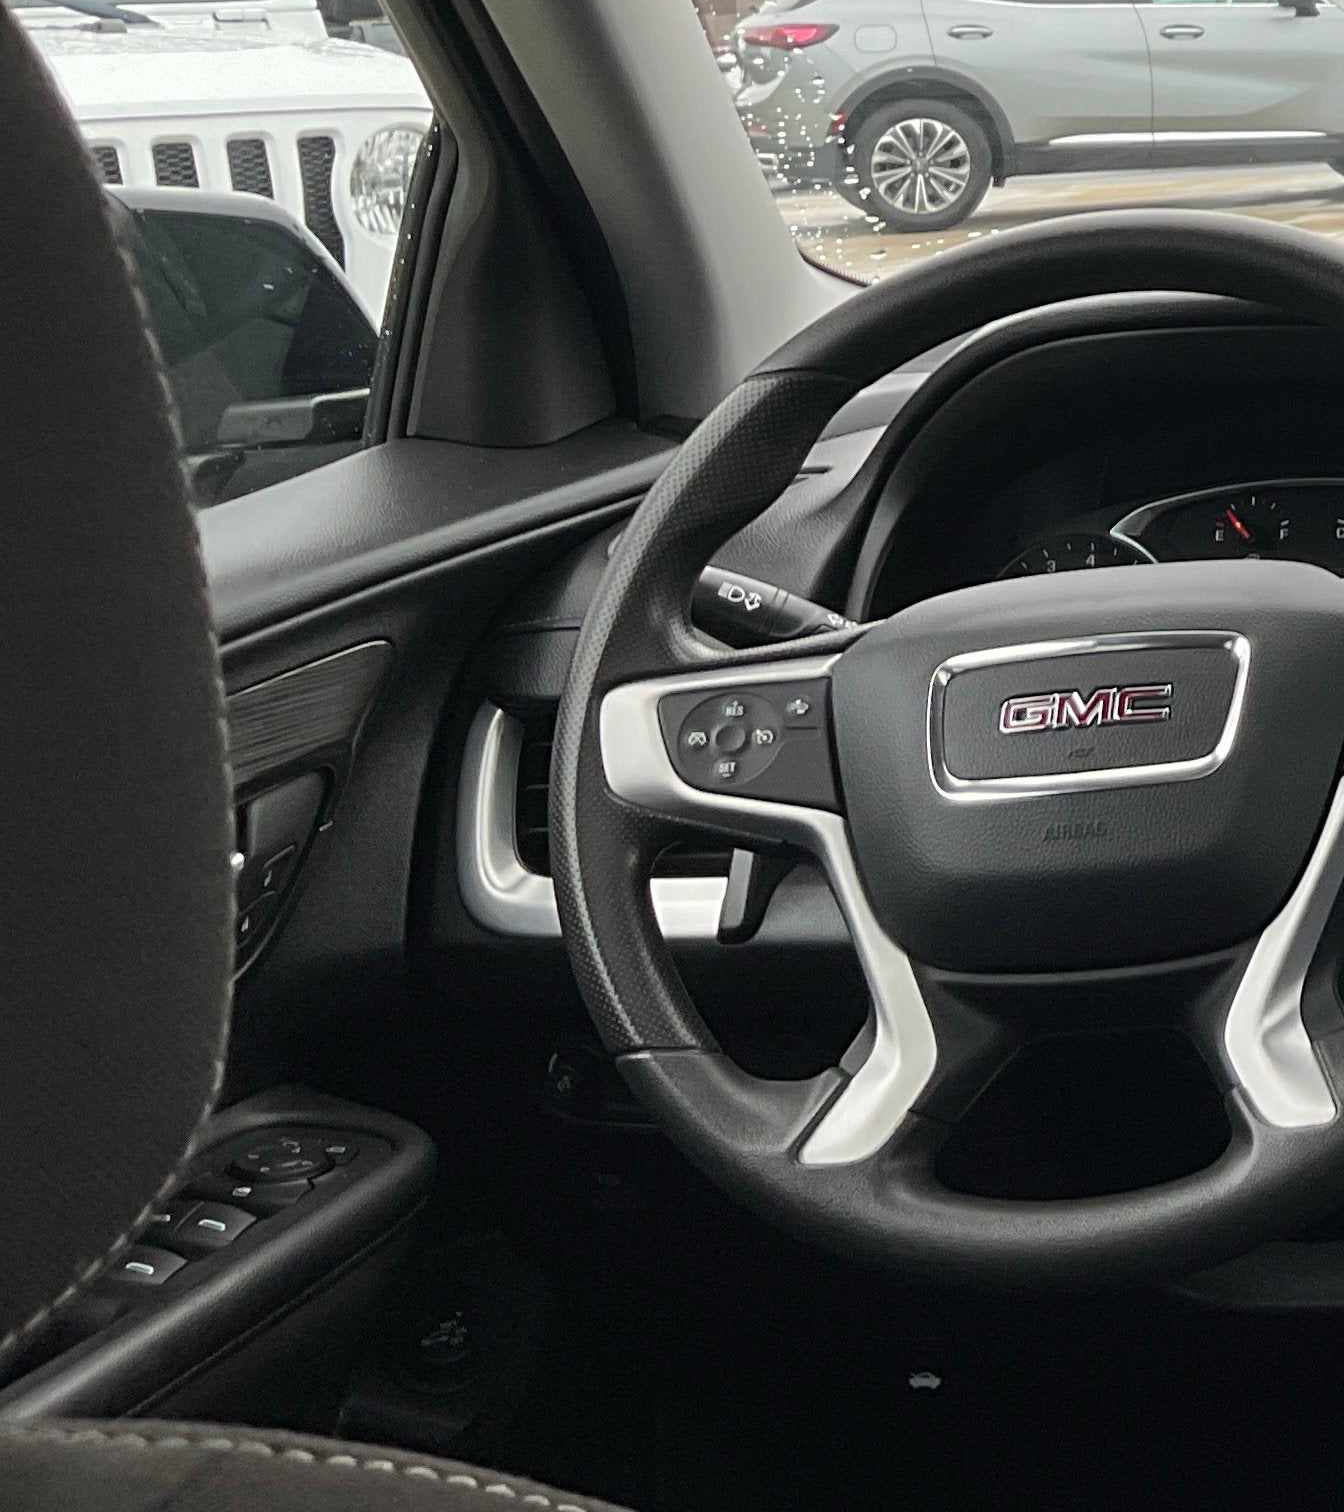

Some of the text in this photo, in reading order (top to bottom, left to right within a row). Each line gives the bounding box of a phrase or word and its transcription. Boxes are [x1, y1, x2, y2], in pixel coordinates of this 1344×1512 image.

[1215, 529, 1224, 541] E
[1280, 528, 1289, 540] F
[1085, 553, 1095, 568] 4
[999, 683, 1173, 734] GMC
